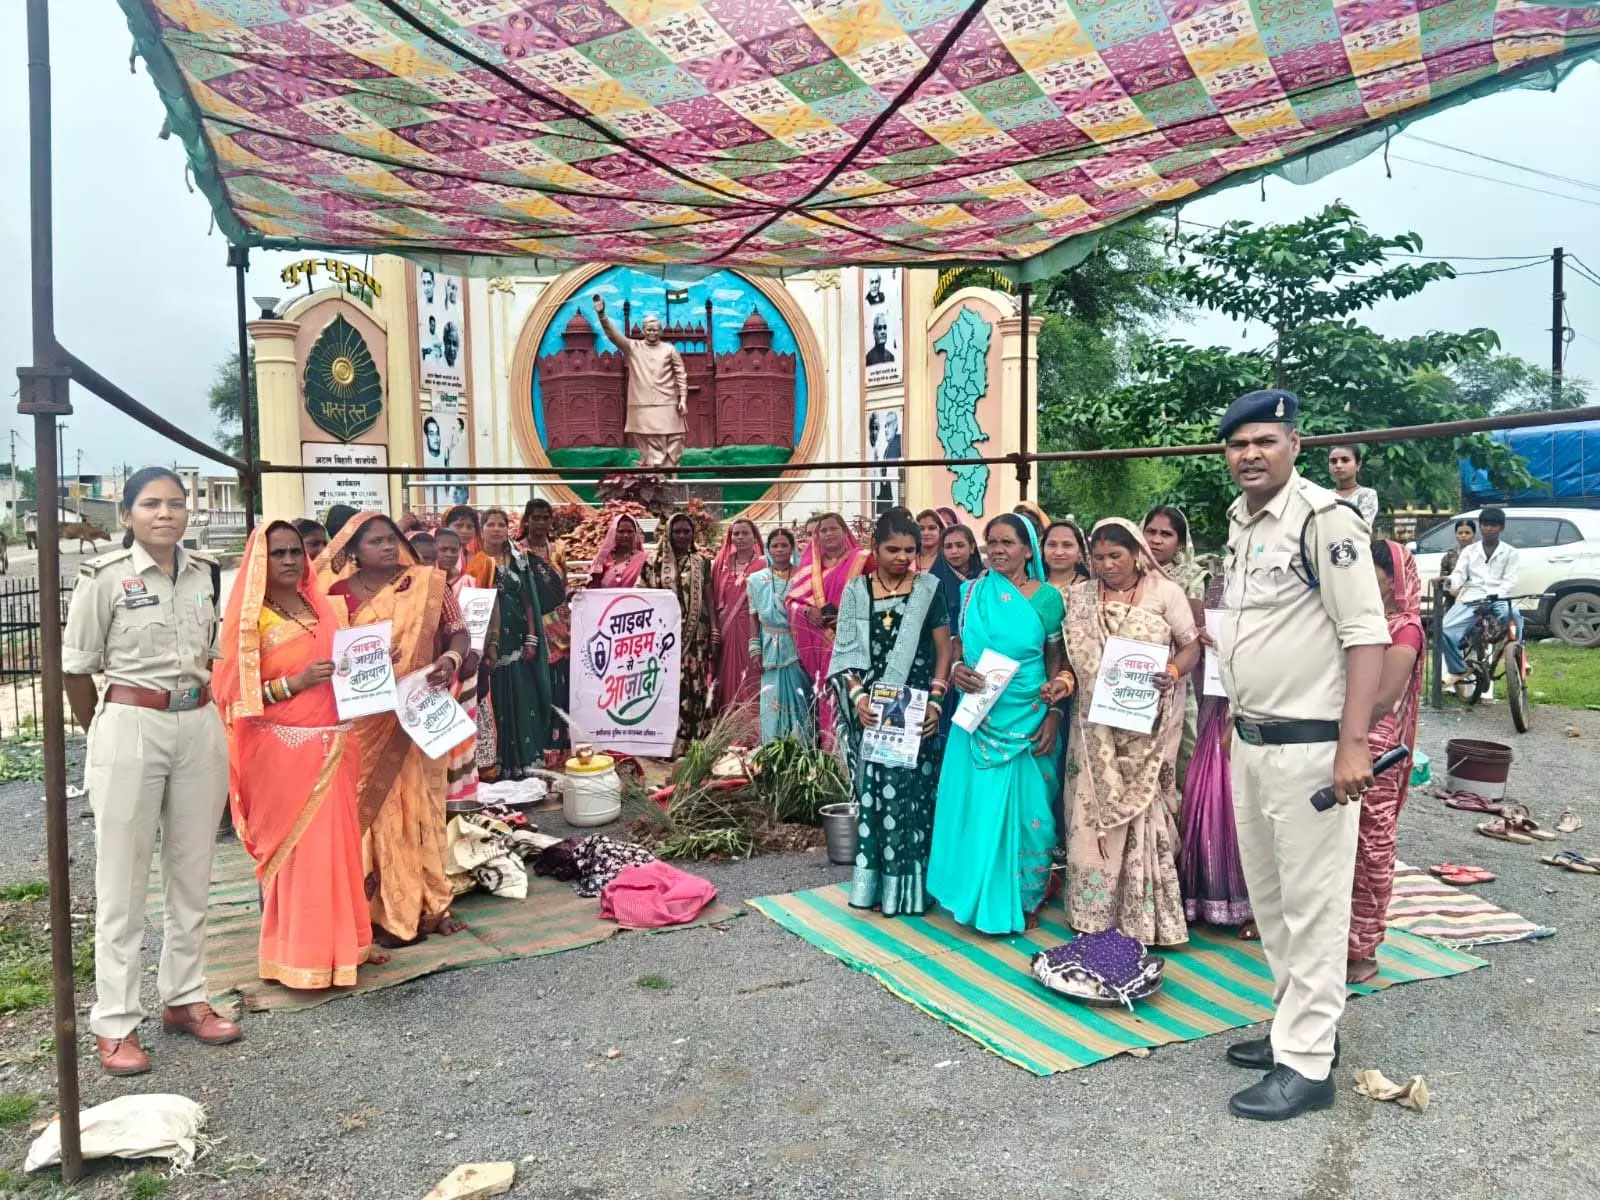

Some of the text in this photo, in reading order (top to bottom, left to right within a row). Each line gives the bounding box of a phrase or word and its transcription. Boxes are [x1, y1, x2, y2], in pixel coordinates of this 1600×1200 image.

[320, 401, 345, 423] भारत
[315, 456, 331, 464] अटल
[334, 454, 352, 465] बिहारी
[610, 608, 655, 635] साइबर
[352, 640, 381, 653] साइबर
[614, 632, 656, 659] क्राइम
[355, 648, 385, 665] जागृति
[626, 656, 635, 671] से
[350, 664, 388, 686] अभियान
[598, 656, 661, 710] आज़ादी
[1112, 686, 1155, 700] अभियान
